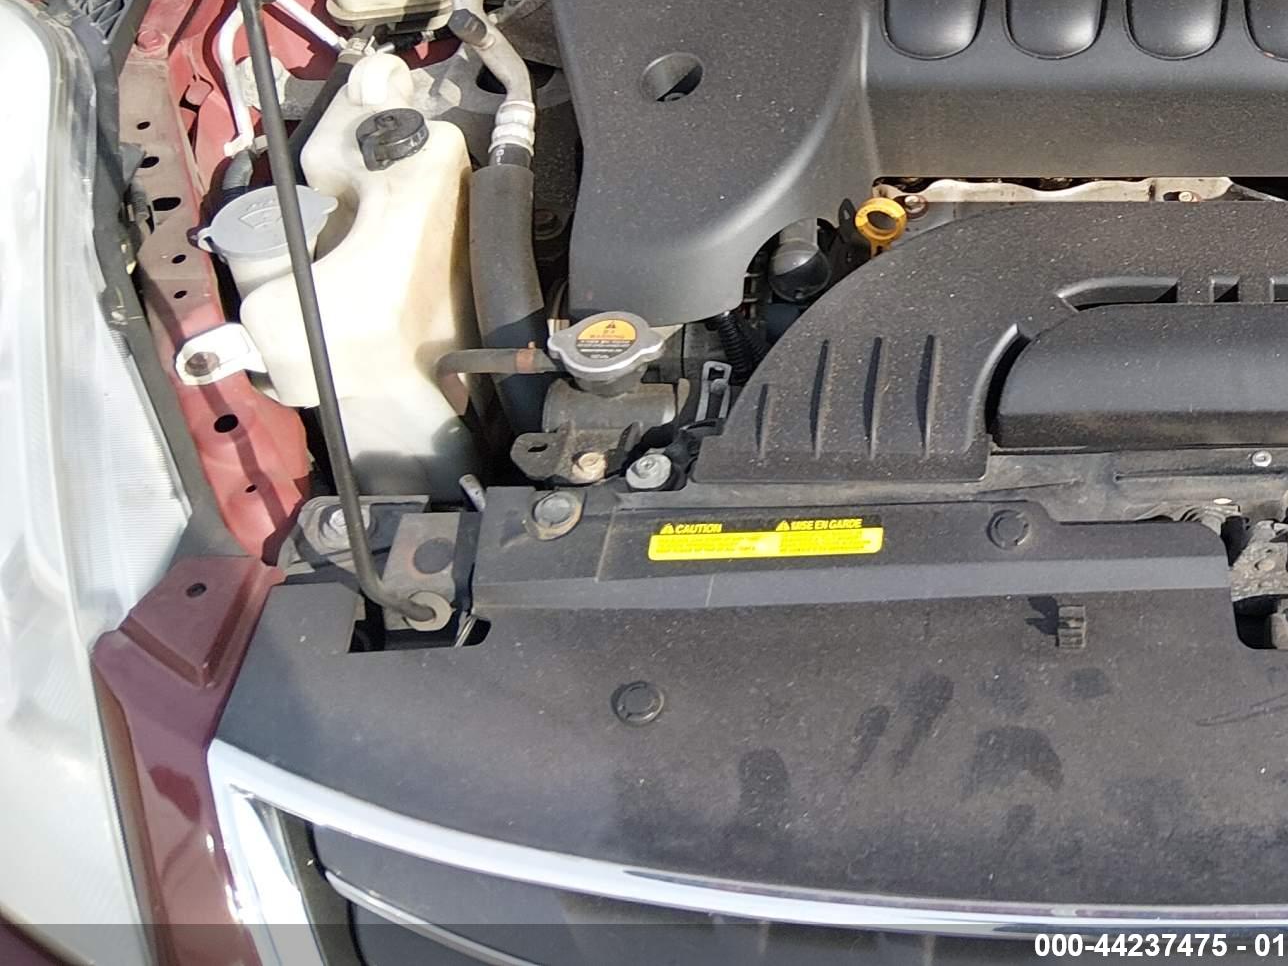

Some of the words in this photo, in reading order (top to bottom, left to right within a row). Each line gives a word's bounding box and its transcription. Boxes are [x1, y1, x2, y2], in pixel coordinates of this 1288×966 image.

[675, 523, 723, 534] CAUTION
[790, 520, 815, 531] MISE
[814, 519, 830, 530] EN
[829, 518, 864, 530] GARDE
